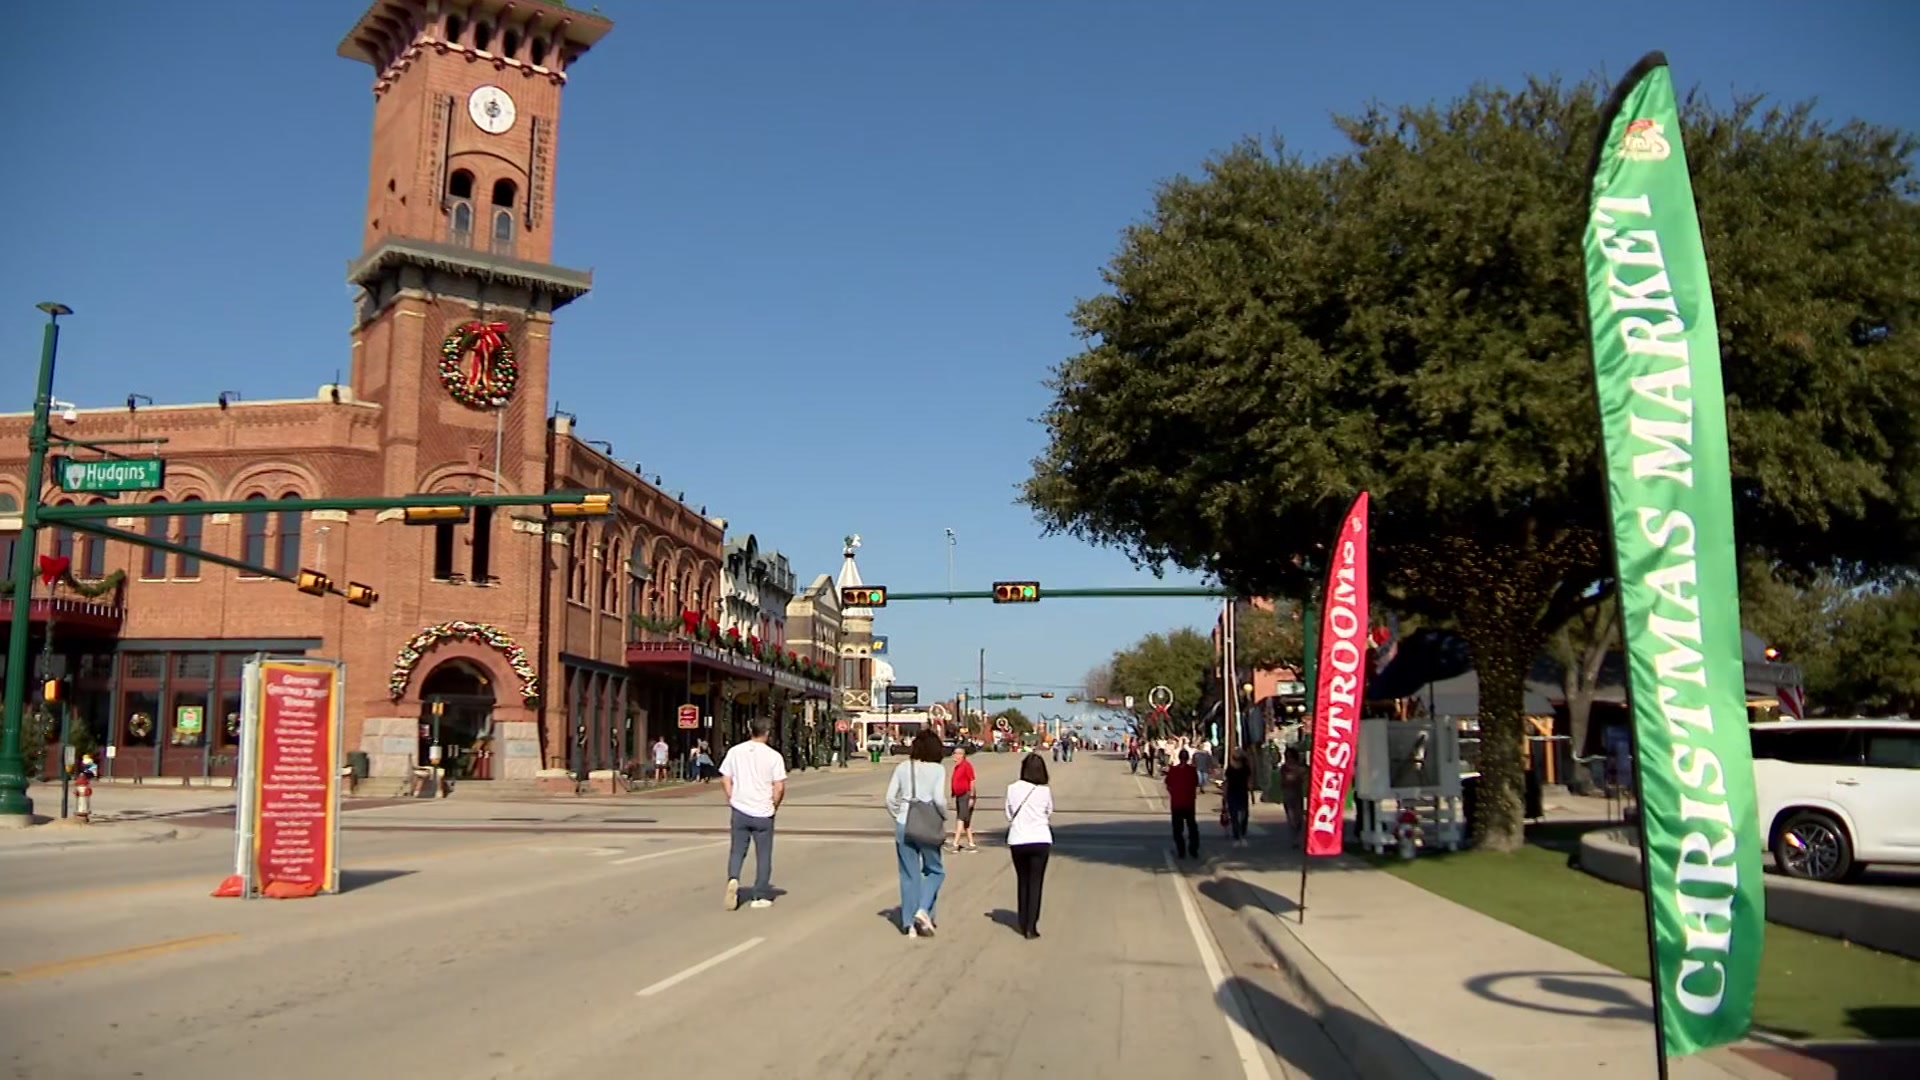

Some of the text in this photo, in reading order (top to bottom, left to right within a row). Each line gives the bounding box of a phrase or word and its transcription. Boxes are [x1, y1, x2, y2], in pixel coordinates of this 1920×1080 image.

[87, 463, 145, 485] Hudgins
[1594, 194, 1693, 488] MARKET
[1312, 541, 1359, 834] RESTROOMS
[1638, 507, 1737, 1015] CHRISTMAS
